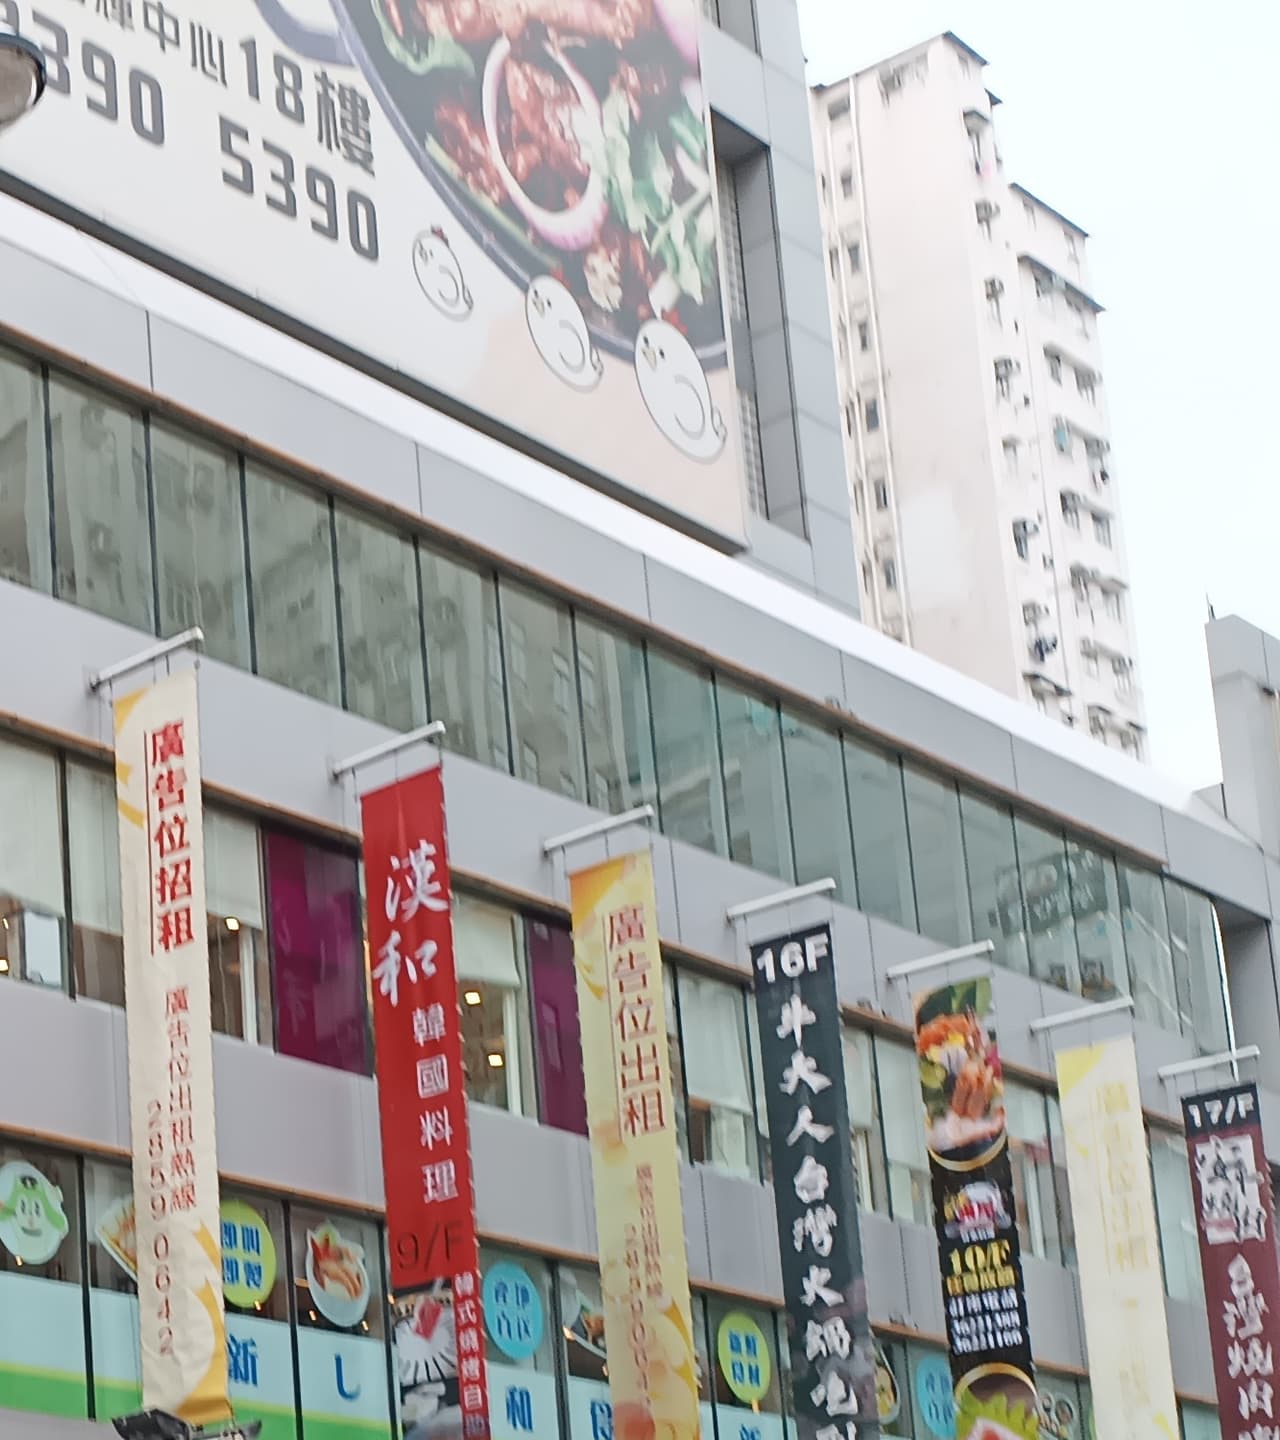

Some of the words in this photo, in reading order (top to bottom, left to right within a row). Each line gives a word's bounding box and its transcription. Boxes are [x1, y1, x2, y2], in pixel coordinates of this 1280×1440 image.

[218, 113, 381, 263] 5390
[151, 718, 195, 954] 廣告位招租
[608, 904, 667, 1138] 廣告位出租
[756, 932, 830, 985] 16F
[411, 1001, 458, 1205] 韓國料理
[1188, 1091, 1255, 1129] 17/F
[395, 1219, 465, 1273] 9/F
